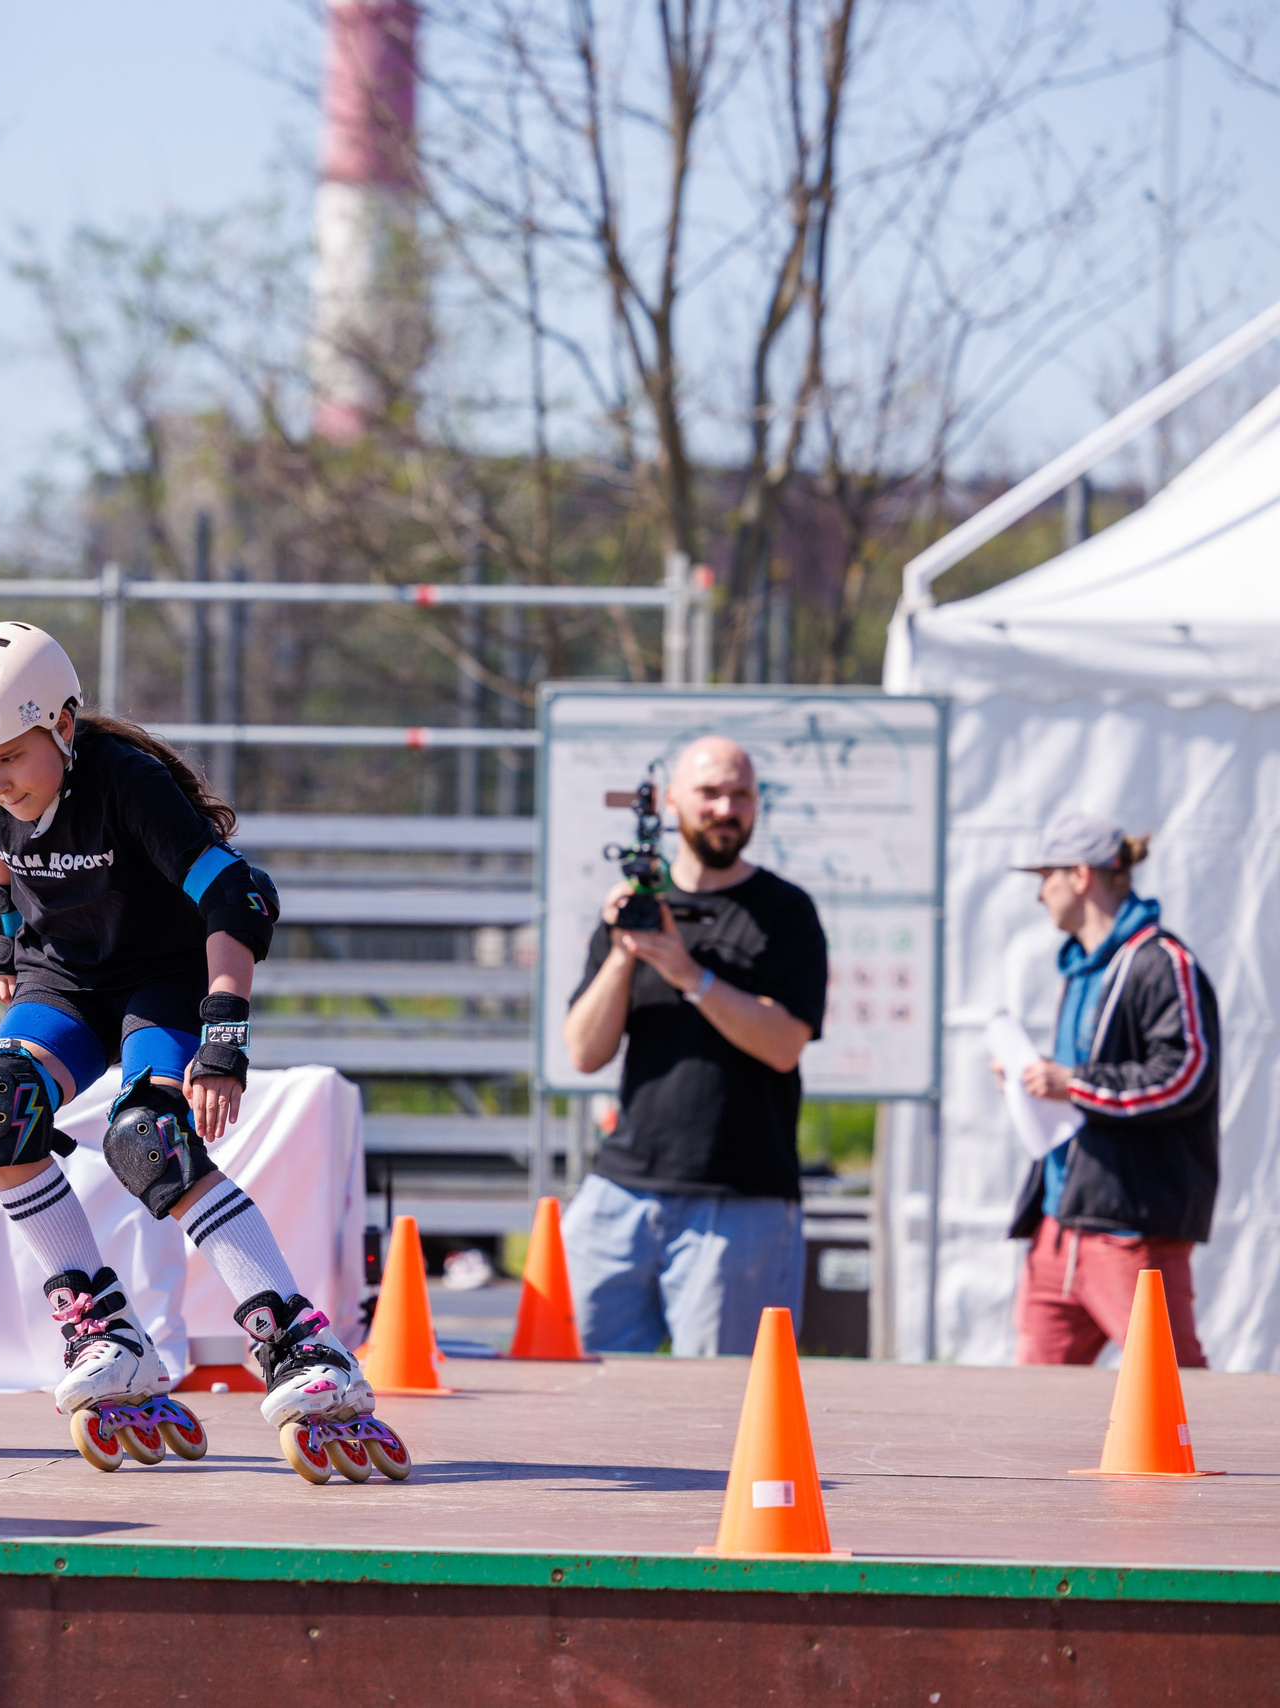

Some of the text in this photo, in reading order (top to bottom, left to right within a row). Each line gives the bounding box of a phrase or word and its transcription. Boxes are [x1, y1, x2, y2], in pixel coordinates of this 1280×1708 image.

[49, 849, 114, 871] ДОРОГУ
[30, 869, 67, 879] КОМАНДА
[209, 1033, 242, 1043] 187
